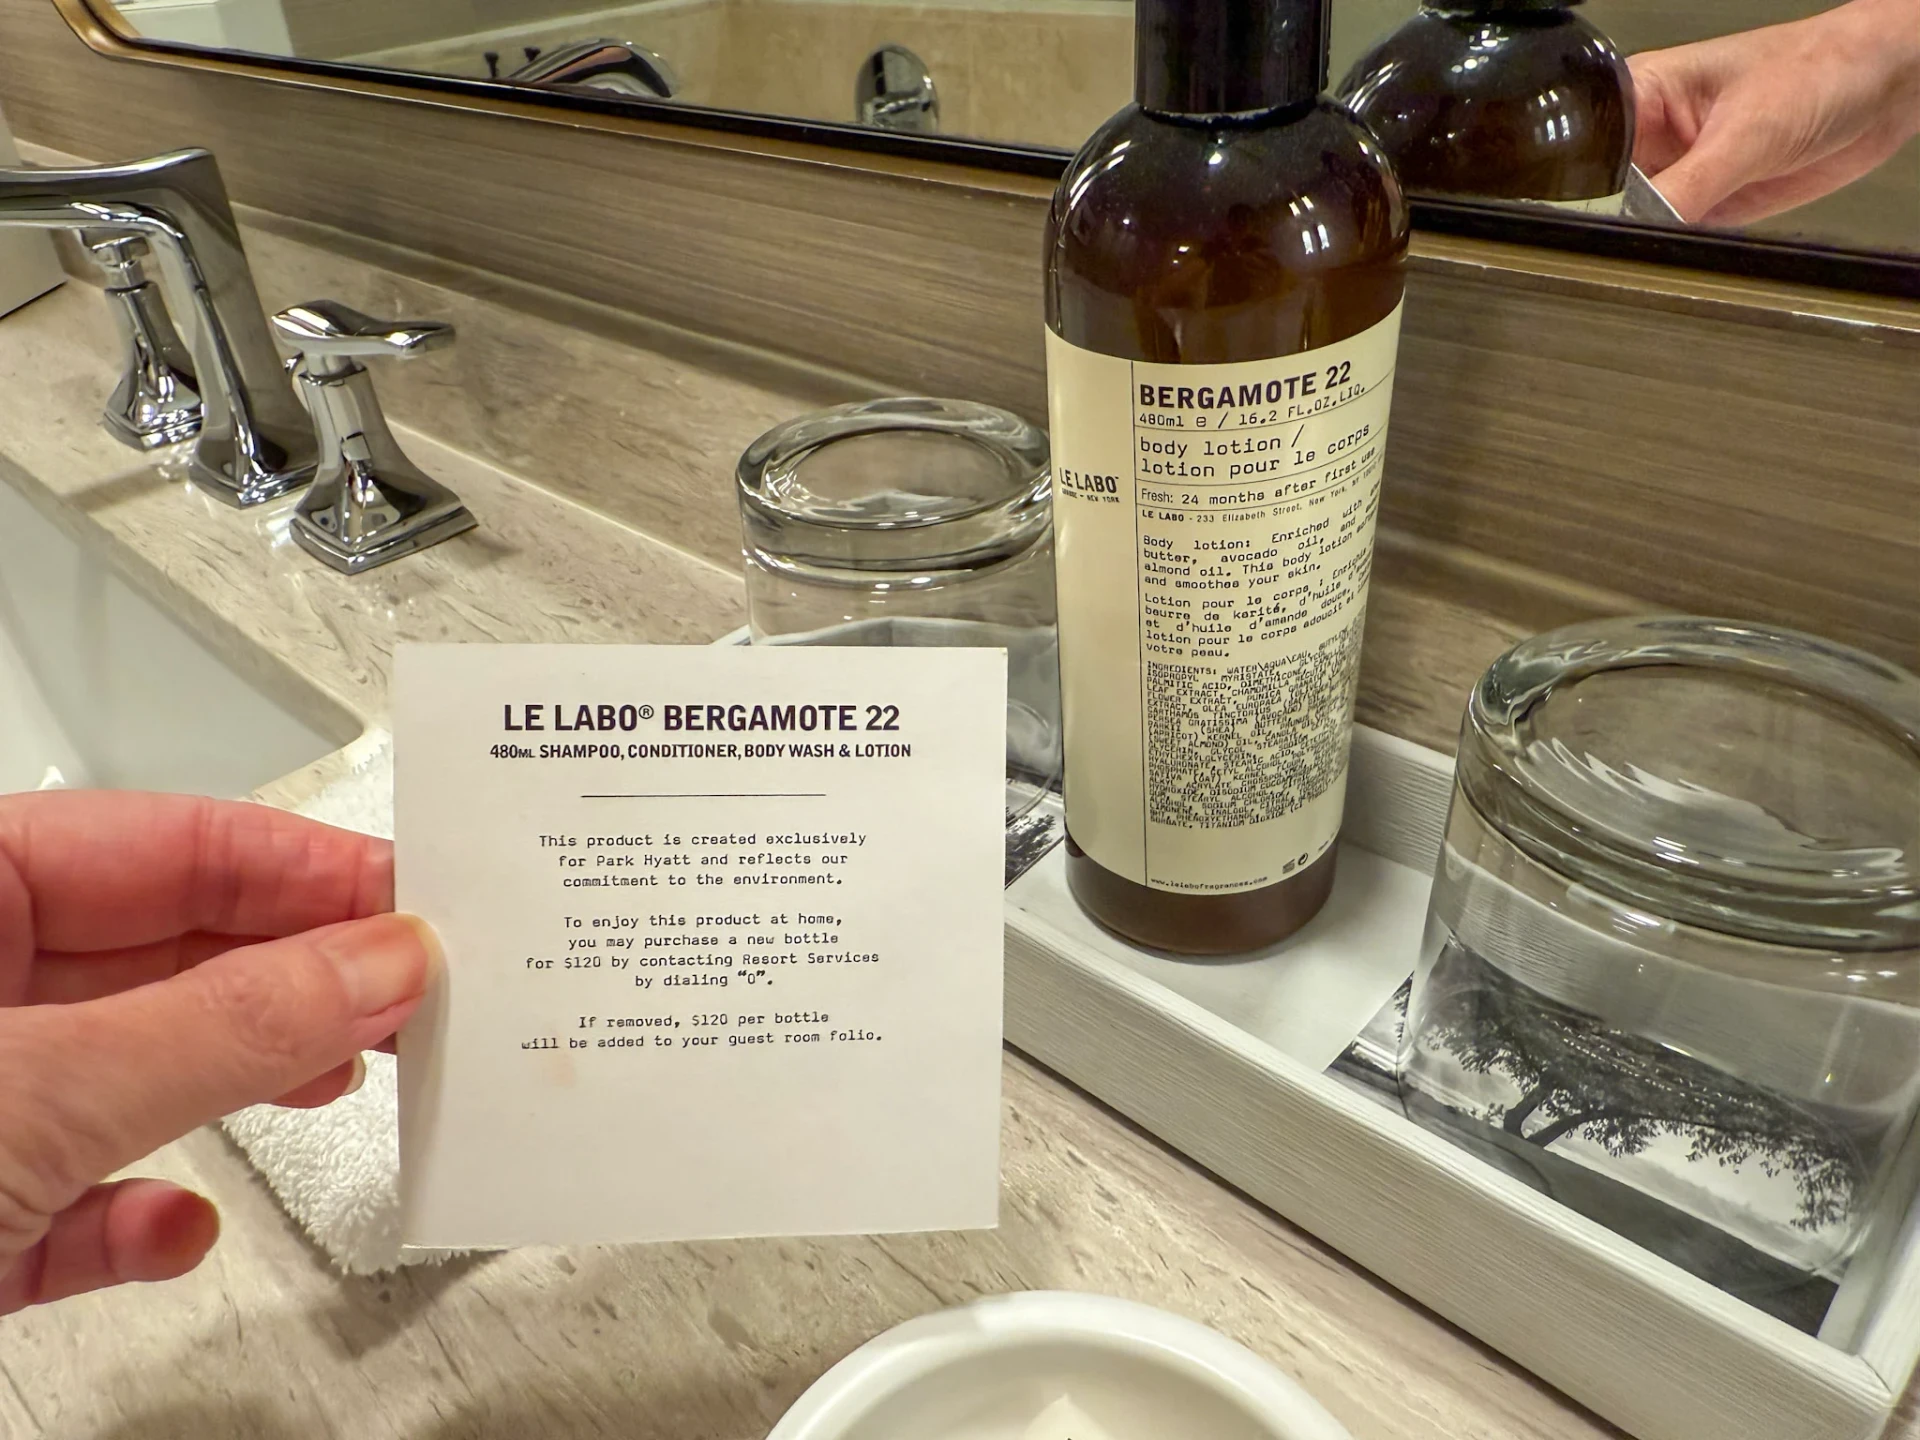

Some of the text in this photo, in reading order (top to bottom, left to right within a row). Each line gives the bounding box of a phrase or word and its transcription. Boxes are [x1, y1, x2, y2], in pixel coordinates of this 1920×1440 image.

[1140, 361, 1351, 409] BERGAMOTE 22
[1139, 413, 1184, 427] 480ml
[1218, 411, 1229, 429] /
[1239, 410, 1277, 426] 16.2
[1140, 424, 1304, 458] body lotion /
[1141, 424, 1369, 479] lotion pour le corps
[1059, 467, 1073, 488] LE
[1141, 488, 1173, 503] Fresh:
[1181, 494, 1199, 505] 24
[1209, 491, 1265, 505] months
[1275, 480, 1316, 498] after
[1325, 460, 1357, 483] first
[1361, 447, 1375, 464] use
[1142, 509, 1154, 519] LE
[1159, 511, 1184, 522] LABO
[1143, 535, 1174, 550] Body
[1194, 540, 1250, 550] lotion:
[1272, 518, 1330, 543] Enriched
[1342, 500, 1362, 518] with
[1143, 548, 1197, 565] butter,
[1221, 548, 1278, 563] avocado
[1297, 536, 1324, 550] oil,
[1340, 516, 1356, 532] and
[1144, 532, 1352, 577] almond oil. This body lotion
[1144, 563, 1321, 590] and smoothes your skin.
[1145, 593, 1191, 608] Lotion
[1202, 600, 1235, 610] pour
[1246, 596, 1262, 606] le
[1273, 585, 1309, 601] corps
[1145, 605, 1191, 620] beurre
[1204, 611, 1220, 621] de
[1233, 602, 1286, 619] karité,
[1146, 630, 1191, 644] lotion
[1198, 637, 1230, 647] pour
[1238, 634, 1253, 643] le
[1261, 625, 1297, 640] corps
[1303, 602, 1342, 629] adoucit
[1146, 619, 1160, 629] et
[1176, 620, 1232, 632] d'huile
[1146, 643, 1230, 658] votre peau.
[505, 704, 545, 731] LE
[664, 705, 857, 731] BERGAMOTE
[865, 705, 899, 731] 22
[540, 744, 624, 761] SHAMPOO,
[628, 744, 741, 760] CONDITIONER,
[745, 744, 785, 758] BODY
[788, 744, 834, 758] WASH
[839, 744, 851, 758] &
[855, 744, 911, 757] LOTION
[539, 832, 866, 848] This product is created exclusively
[559, 853, 848, 868] for Park Hyatt and reflects our
[563, 873, 842, 887] commitment to the environment.
[564, 913, 841, 929] To enjoy this product at home,
[568, 932, 838, 950] you may purchase a new bottle
[526, 952, 879, 969] for $120 by contacting Resort Services
[636, 976, 653, 989] by
[664, 974, 728, 987] dialing
[579, 1011, 828, 1028] If removed, $120 per bottle
[522, 1029, 881, 1049] will be added to your guest room folio.
